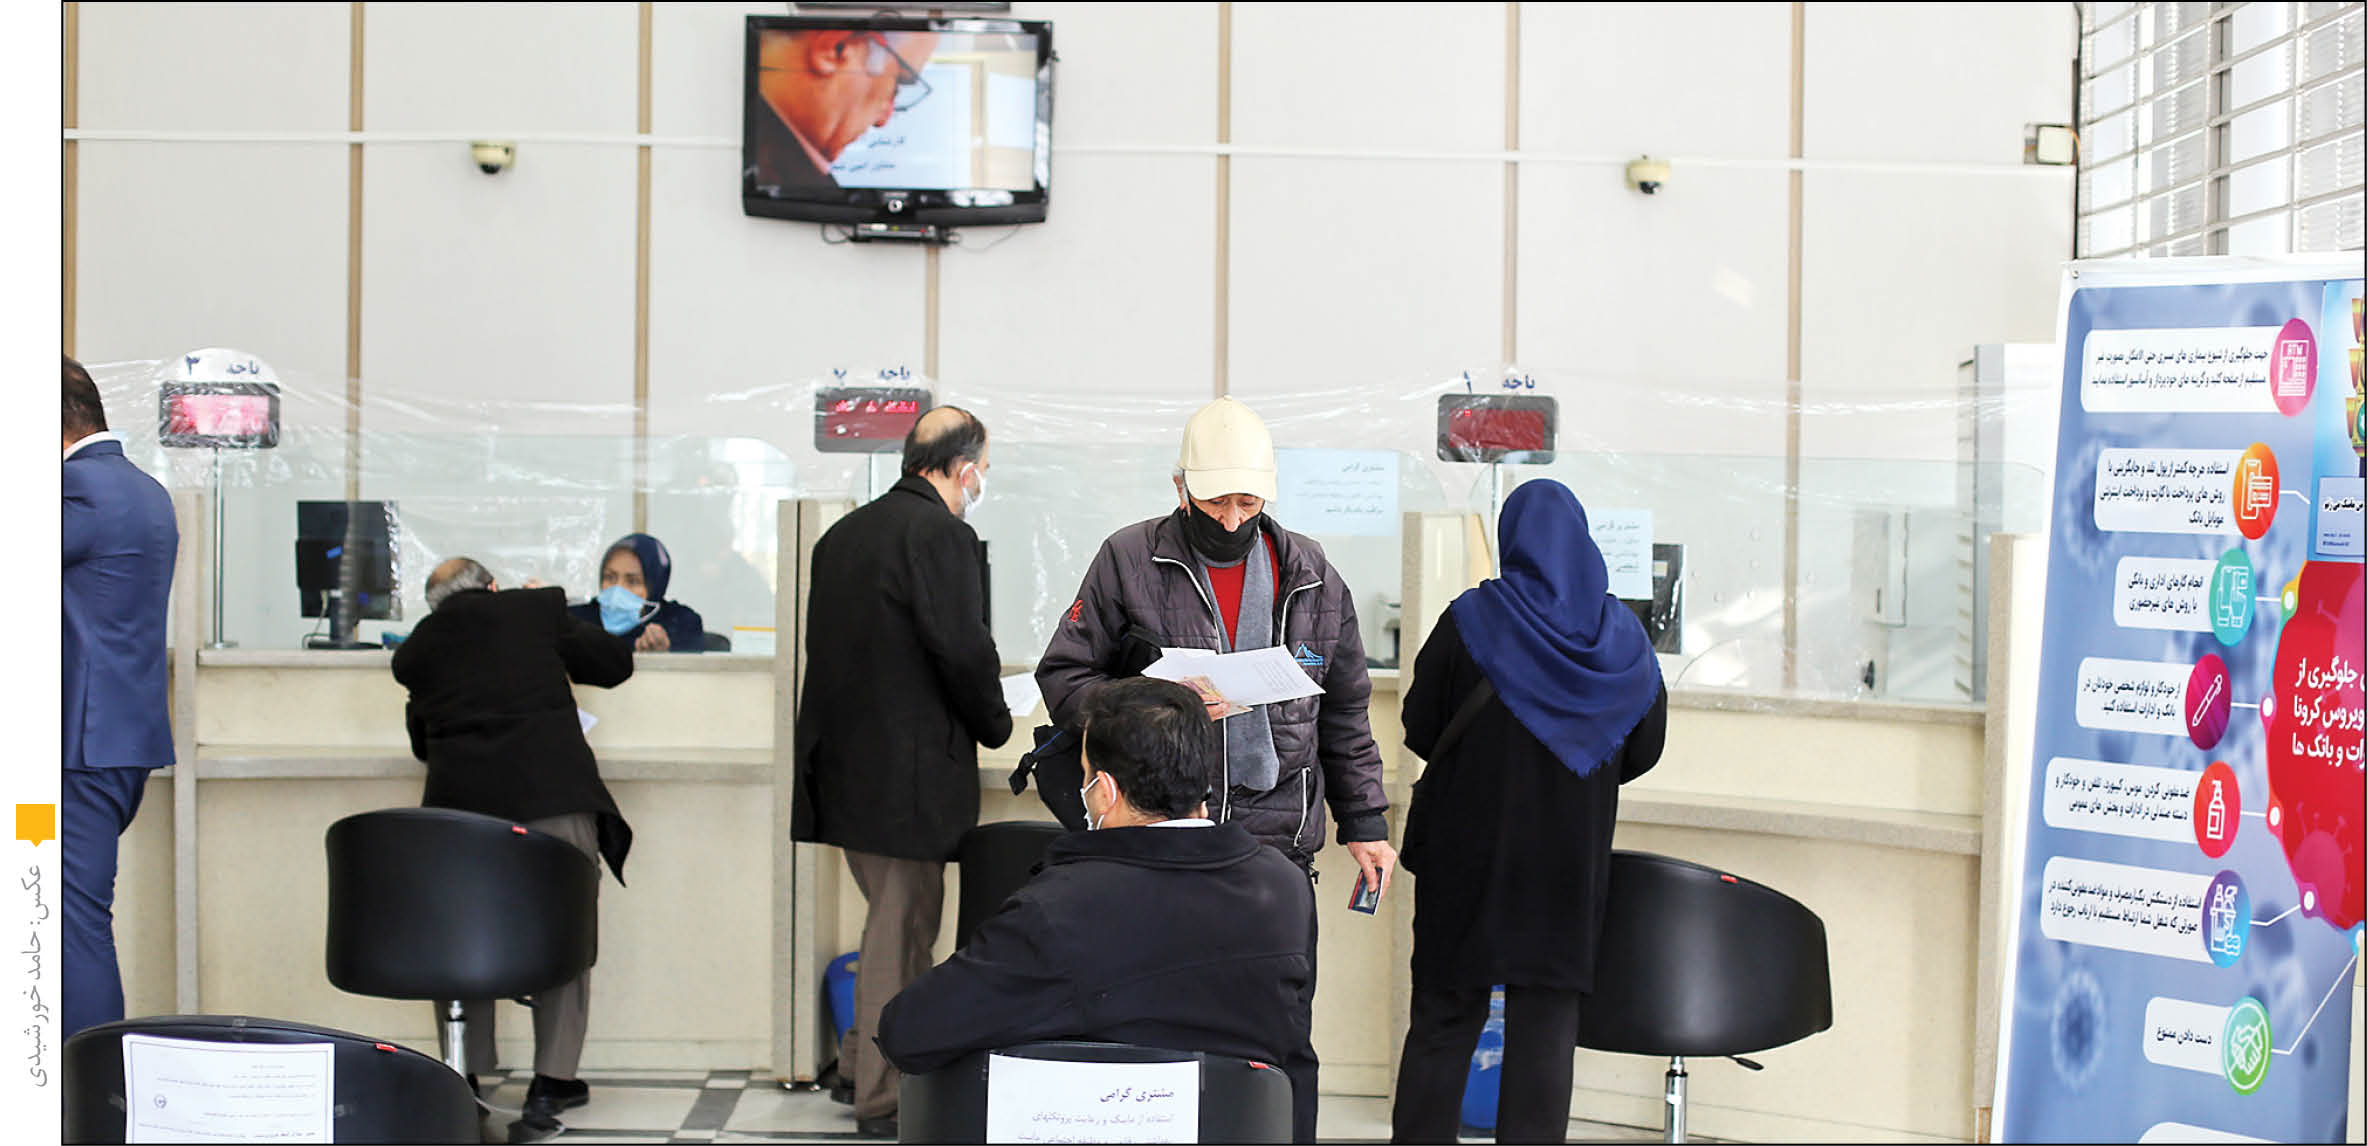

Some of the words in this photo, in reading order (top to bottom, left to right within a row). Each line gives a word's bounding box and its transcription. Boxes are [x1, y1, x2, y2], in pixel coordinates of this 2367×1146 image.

[226, 361, 260, 374] باجه
[1503, 374, 1535, 393] باجه
[2295, 657, 2307, 688] از
[2308, 655, 2358, 690] جلوگیری
[2294, 694, 2323, 726] کرونا
[2322, 707, 2364, 731] ویروس
[2292, 733, 2305, 755] ها
[2307, 734, 2334, 765] بانک
[2335, 746, 2344, 768] و
[1099, 1087, 1132, 1103] گرامی
[1135, 1088, 1174, 1103] مشتری
